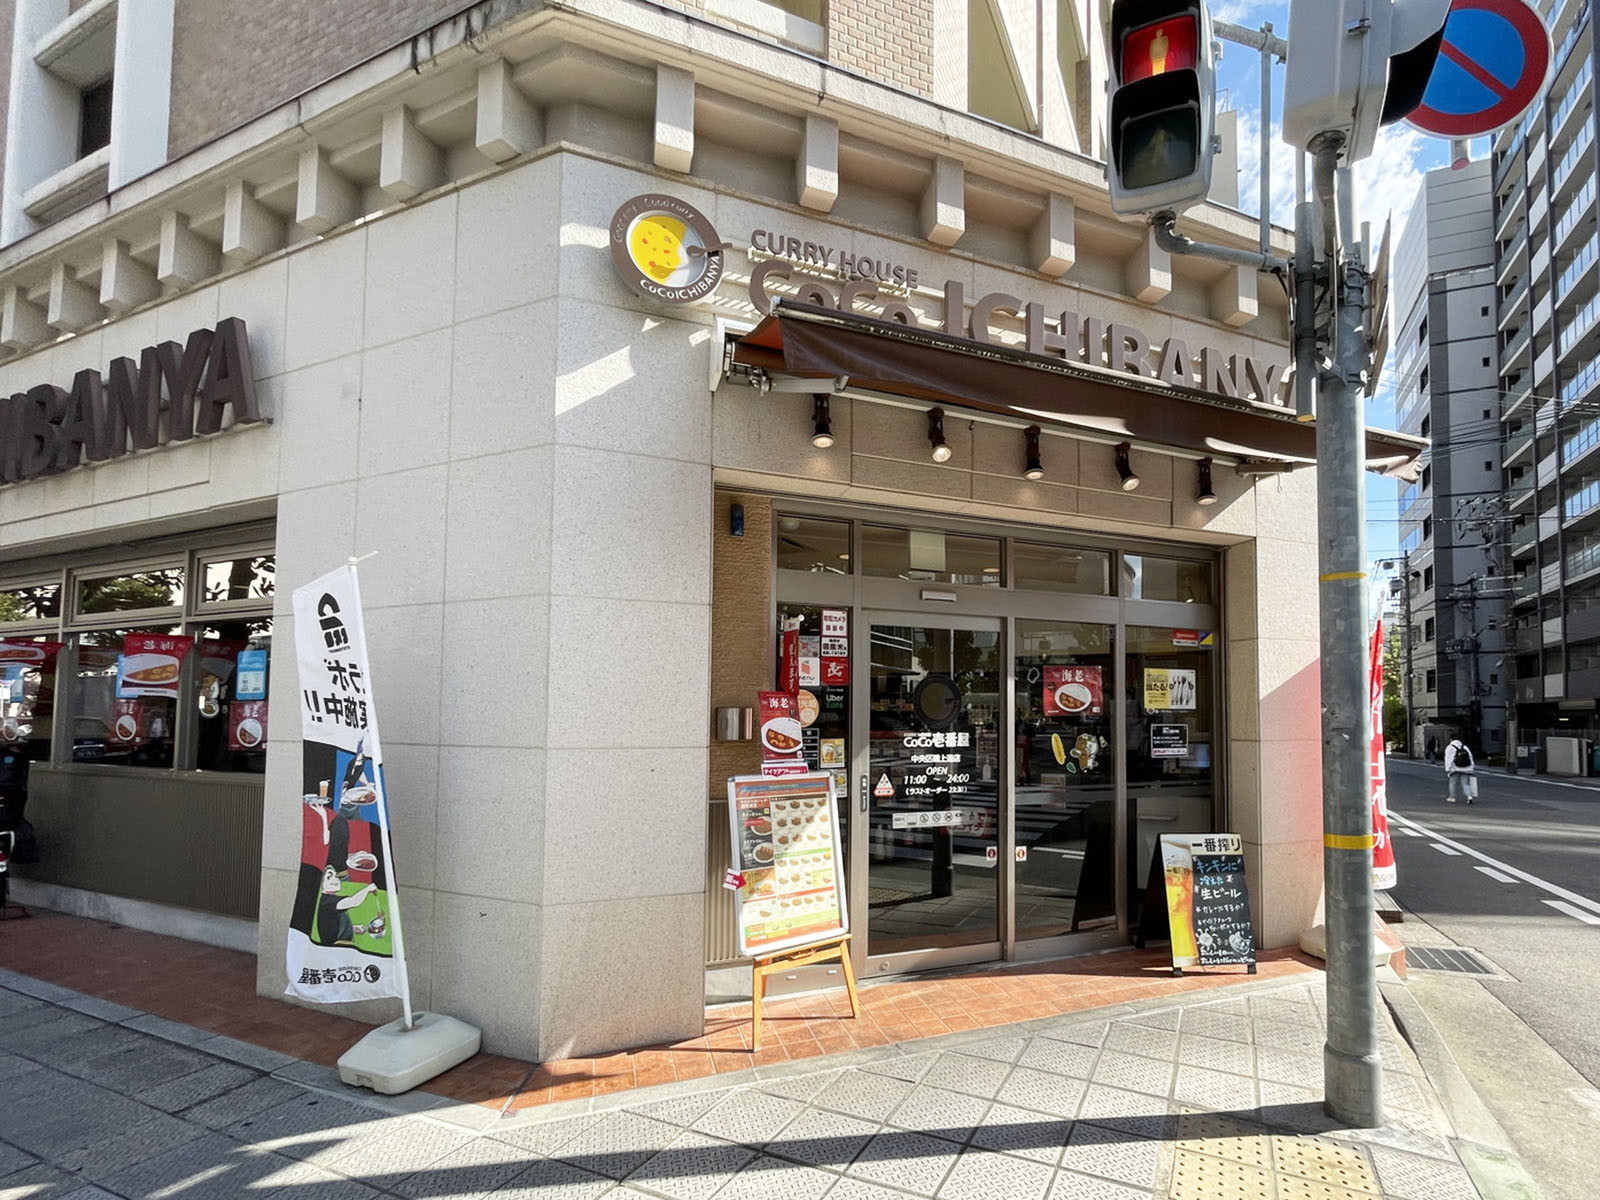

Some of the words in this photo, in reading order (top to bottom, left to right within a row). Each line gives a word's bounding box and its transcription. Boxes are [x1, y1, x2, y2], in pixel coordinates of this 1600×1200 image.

[751, 229, 833, 266] CURRY
[839, 251, 919, 289] HOUSE
[640, 255, 720, 299] CoCoICHIBANYA
[944, 279, 1297, 409] ICHIBANY
[825, 694, 844, 702] Uber
[926, 767, 948, 775] OPEN
[904, 775, 927, 784] 11:00
[946, 774, 970, 783] 24:00
[1192, 838, 1241, 852] 一番搾り
[1201, 888, 1241, 900] 生ビール
